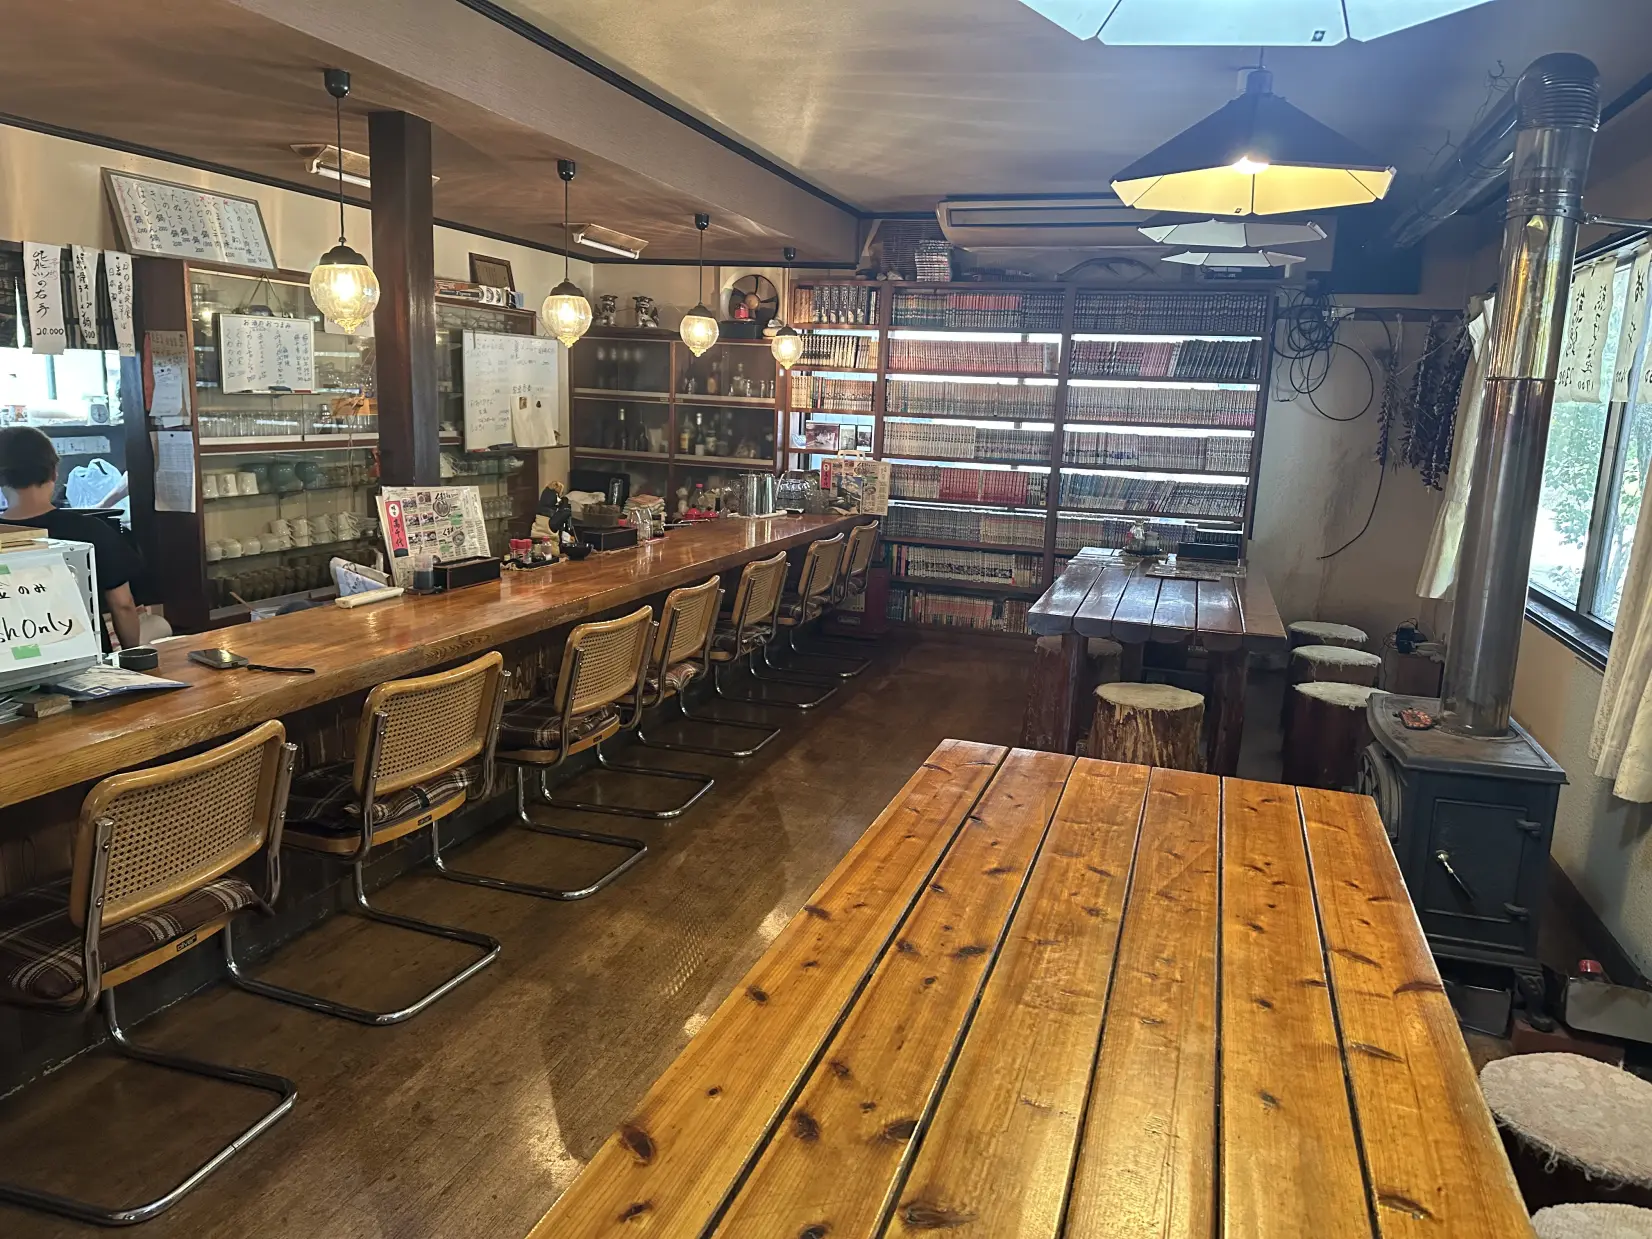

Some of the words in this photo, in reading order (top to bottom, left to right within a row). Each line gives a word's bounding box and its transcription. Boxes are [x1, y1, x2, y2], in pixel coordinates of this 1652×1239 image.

[32, 250, 50, 319] 熊の右手
[22, 612, 73, 640] Only
